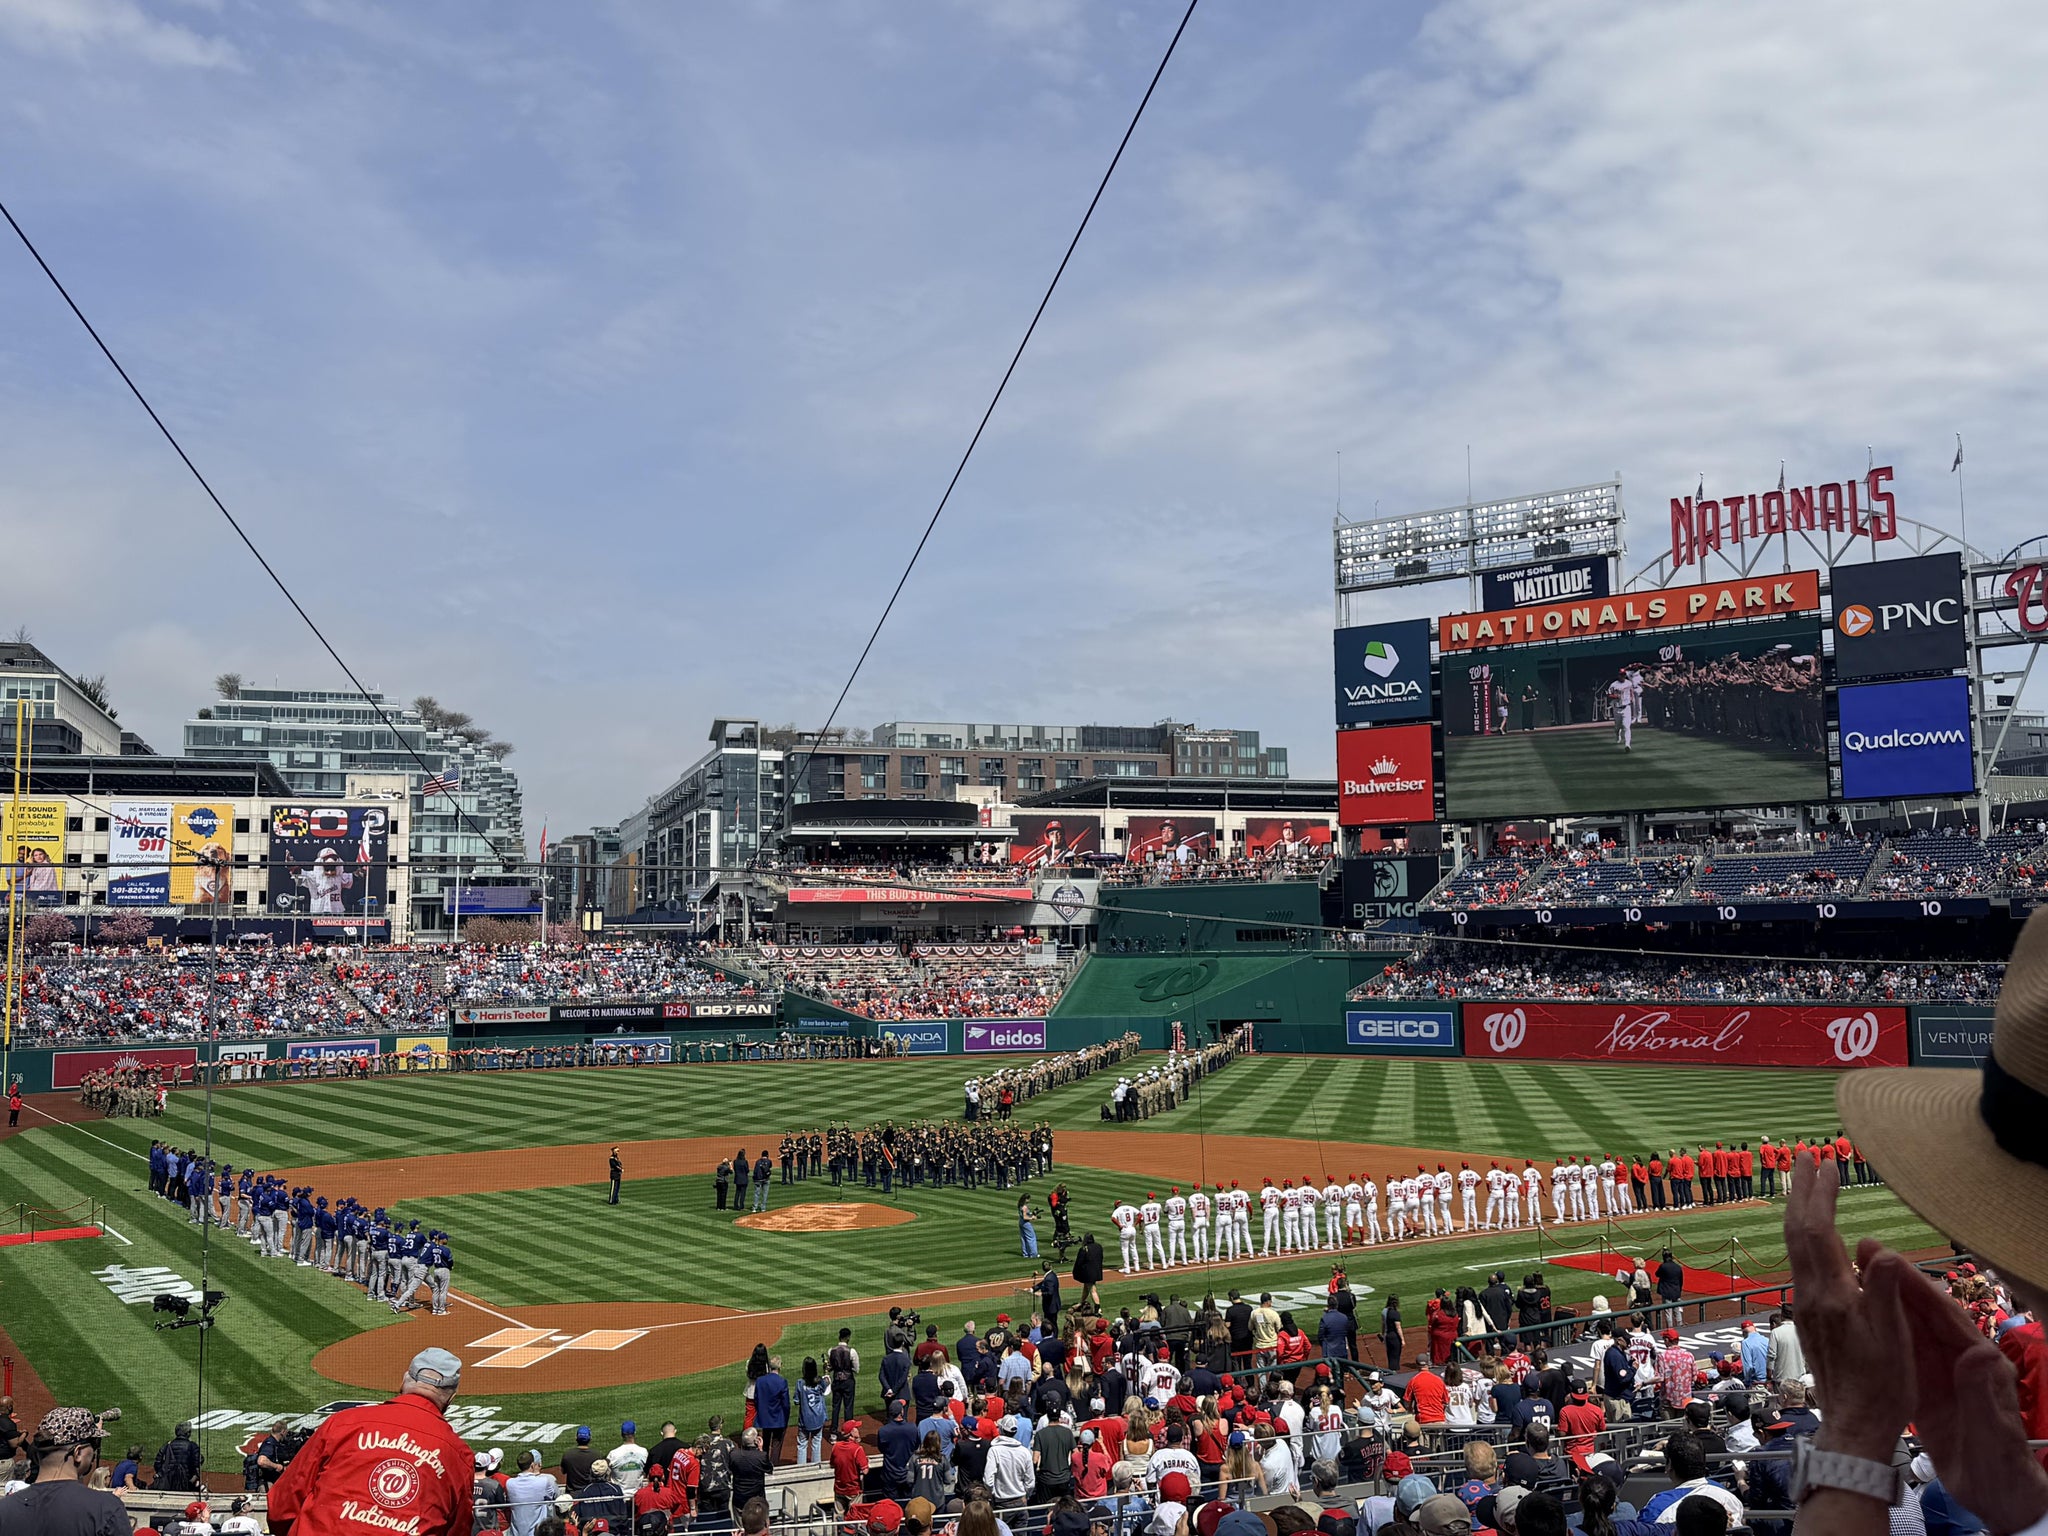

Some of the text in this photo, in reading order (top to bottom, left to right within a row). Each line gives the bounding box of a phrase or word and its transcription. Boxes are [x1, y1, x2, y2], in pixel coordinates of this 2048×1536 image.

[1670, 466, 1897, 568] NATIONALS
[1497, 564, 1553, 581] SHOW SOME
[1513, 567, 1592, 603] NATITUDE
[1450, 582, 1795, 642] NATIONALS PARK
[1878, 599, 1960, 631] PNC
[1344, 680, 1422, 701] VANDA
[1845, 729, 1965, 752] Qualcomm
[1344, 778, 1426, 795] Budweiser
[179, 815, 225, 827] Pedigree
[120, 826, 168, 838] HVAC
[138, 839, 166, 851] 911
[866, 889, 887, 900] THIS
[889, 889, 917, 900] BUD'S
[1623, 908, 1642, 922] 10
[1717, 906, 1737, 920] 10
[1816, 904, 1837, 918] 10
[1920, 901, 1942, 916] 10
[1451, 911, 1468, 925] 10
[1535, 910, 1552, 924] 10
[480, 1010, 548, 1020] Harris Teeter
[560, 1007, 654, 1018] WELCOME TO NATIONALS PARK
[664, 1005, 688, 1016] 12:50
[736, 1004, 771, 1015] FAN
[1359, 1020, 1439, 1037] GEICO
[897, 1033, 942, 1041] VANDA
[991, 1029, 1042, 1046] leidos
[1318, 1413, 1340, 1432] 20
[358, 1431, 446, 1480] Washington
[1163, 1459, 1190, 1469] ABRAMS
[376, 1460, 418, 1485] WASHINGTON
[921, 1464, 933, 1480] 11
[371, 1486, 411, 1506] NATIONALS
[339, 1500, 420, 1536] Nationals
